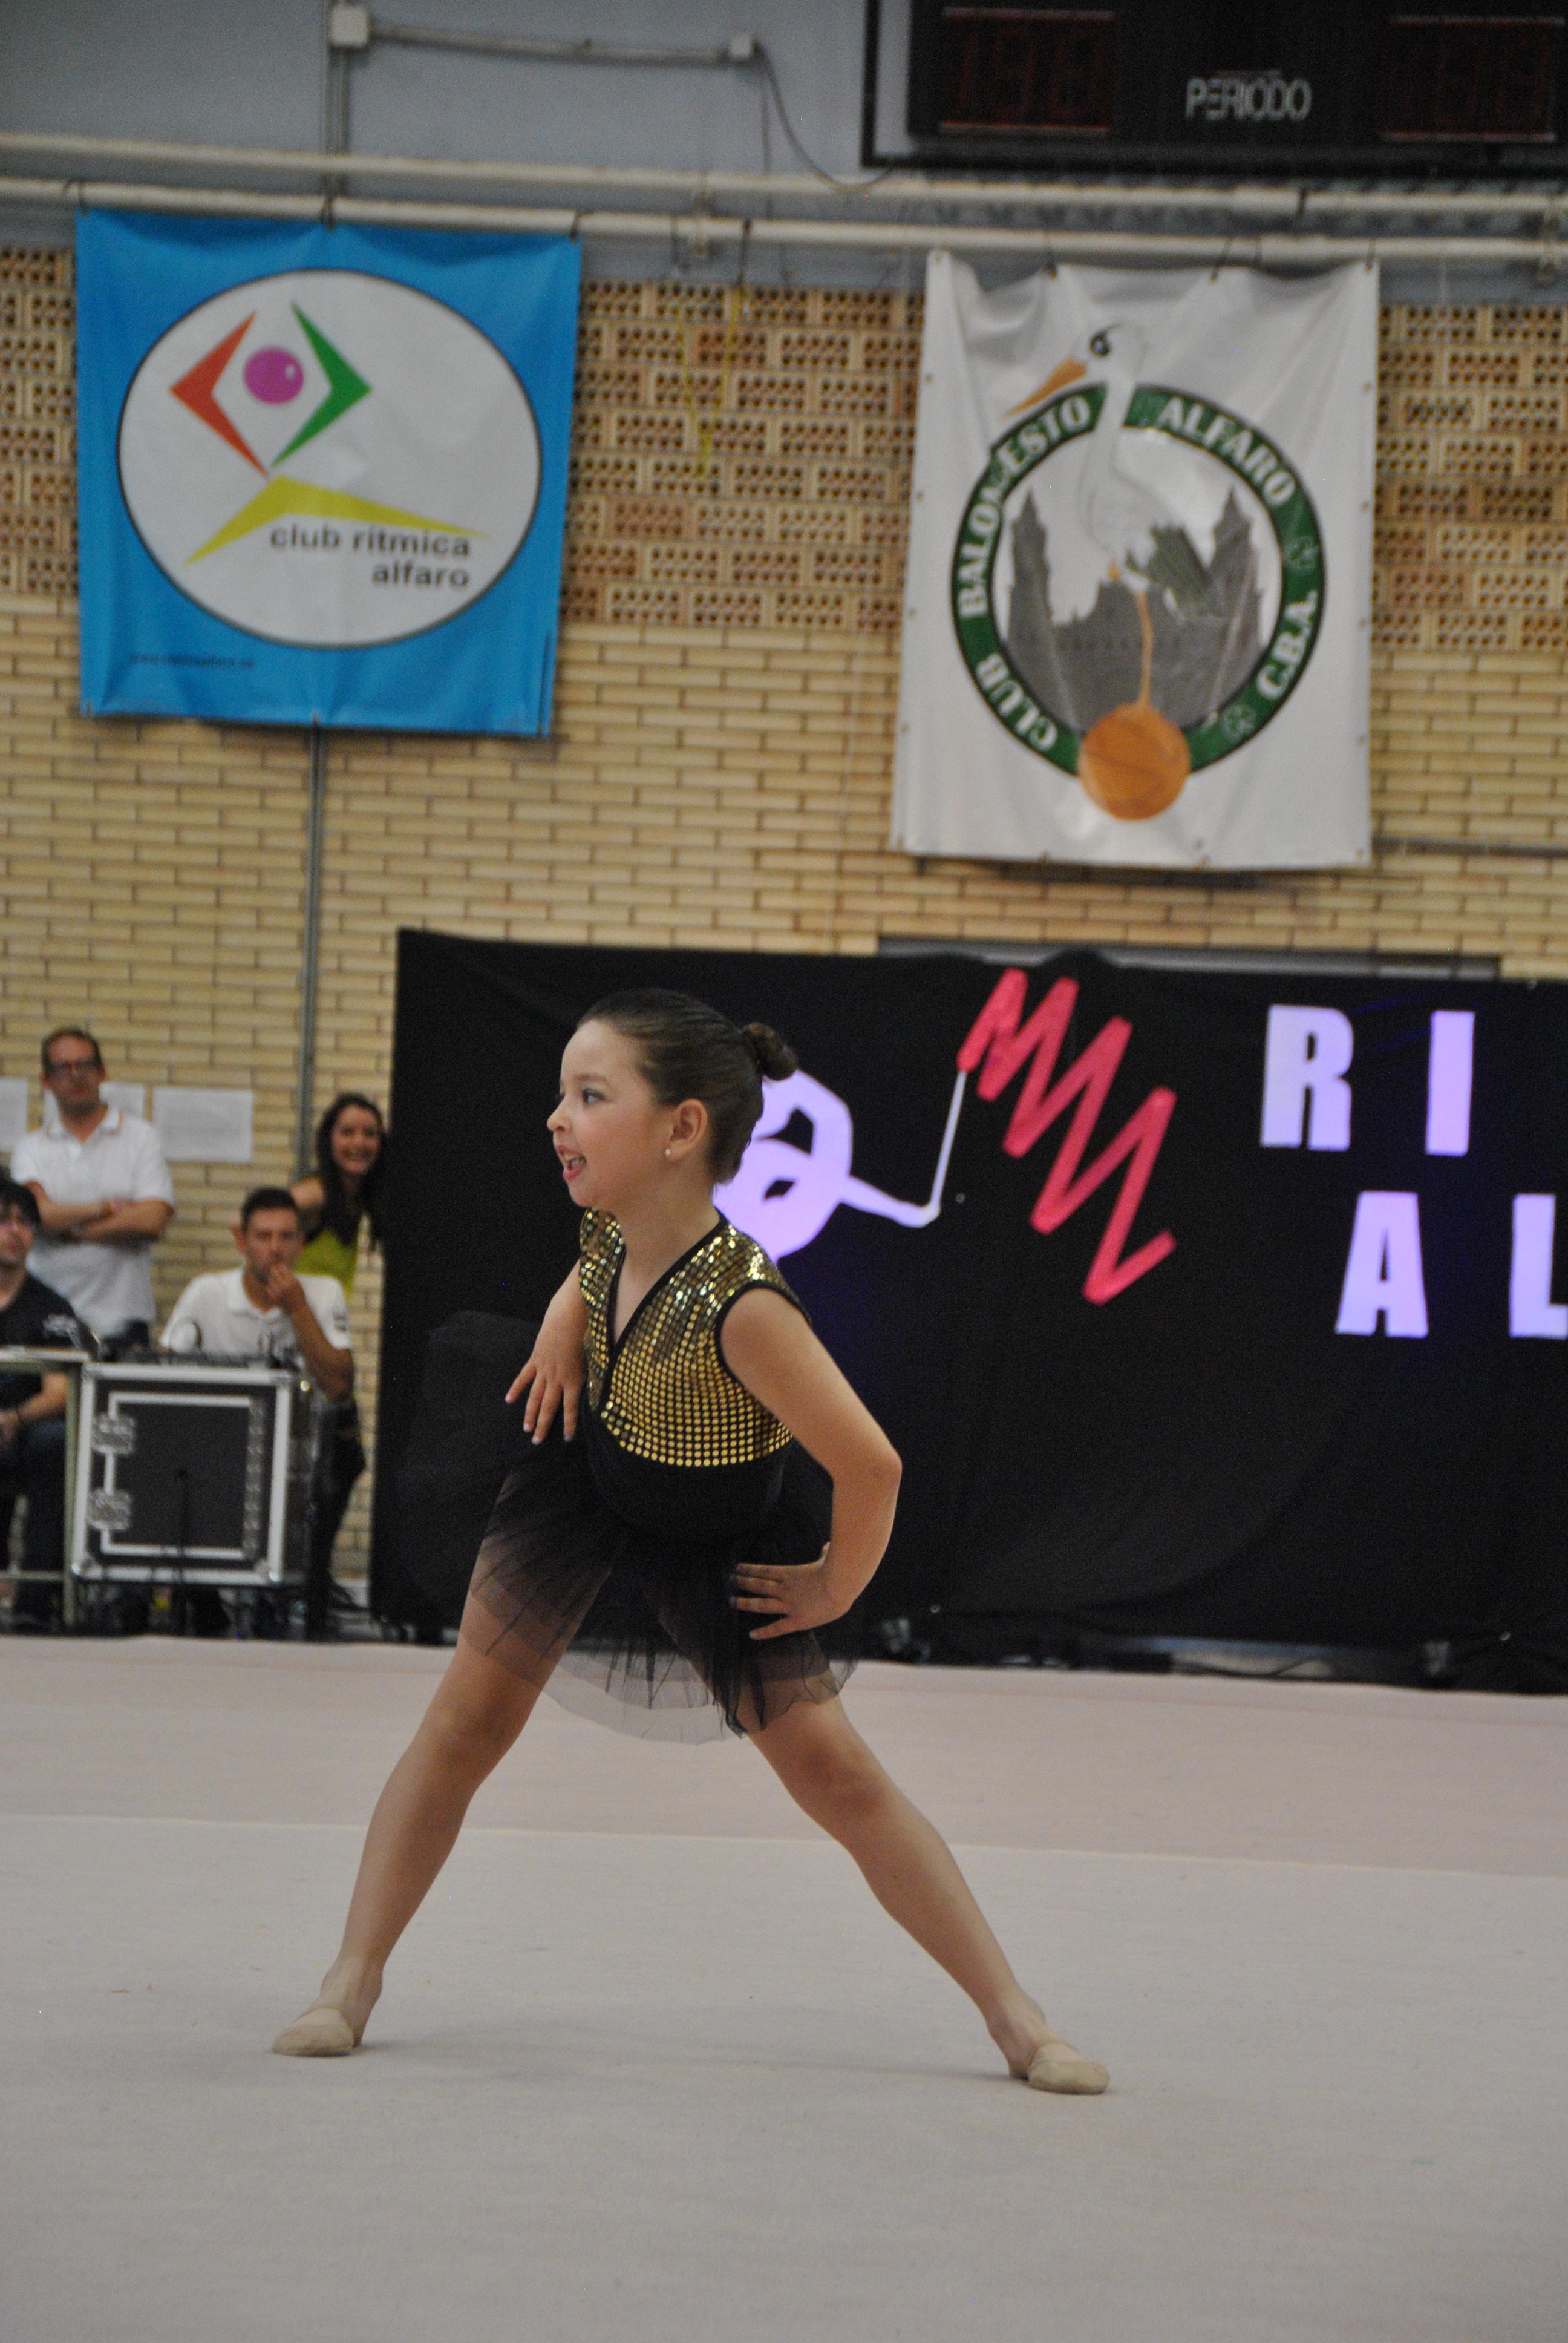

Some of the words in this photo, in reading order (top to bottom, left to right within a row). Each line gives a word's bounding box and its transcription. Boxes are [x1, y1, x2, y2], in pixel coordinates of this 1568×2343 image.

[1186, 77, 1312, 121] PERIODO
[270, 523, 340, 552] club
[371, 559, 469, 589] alfaro
[975, 652, 1059, 751] CLUB
[1154, 395, 1296, 507] ALFARO
